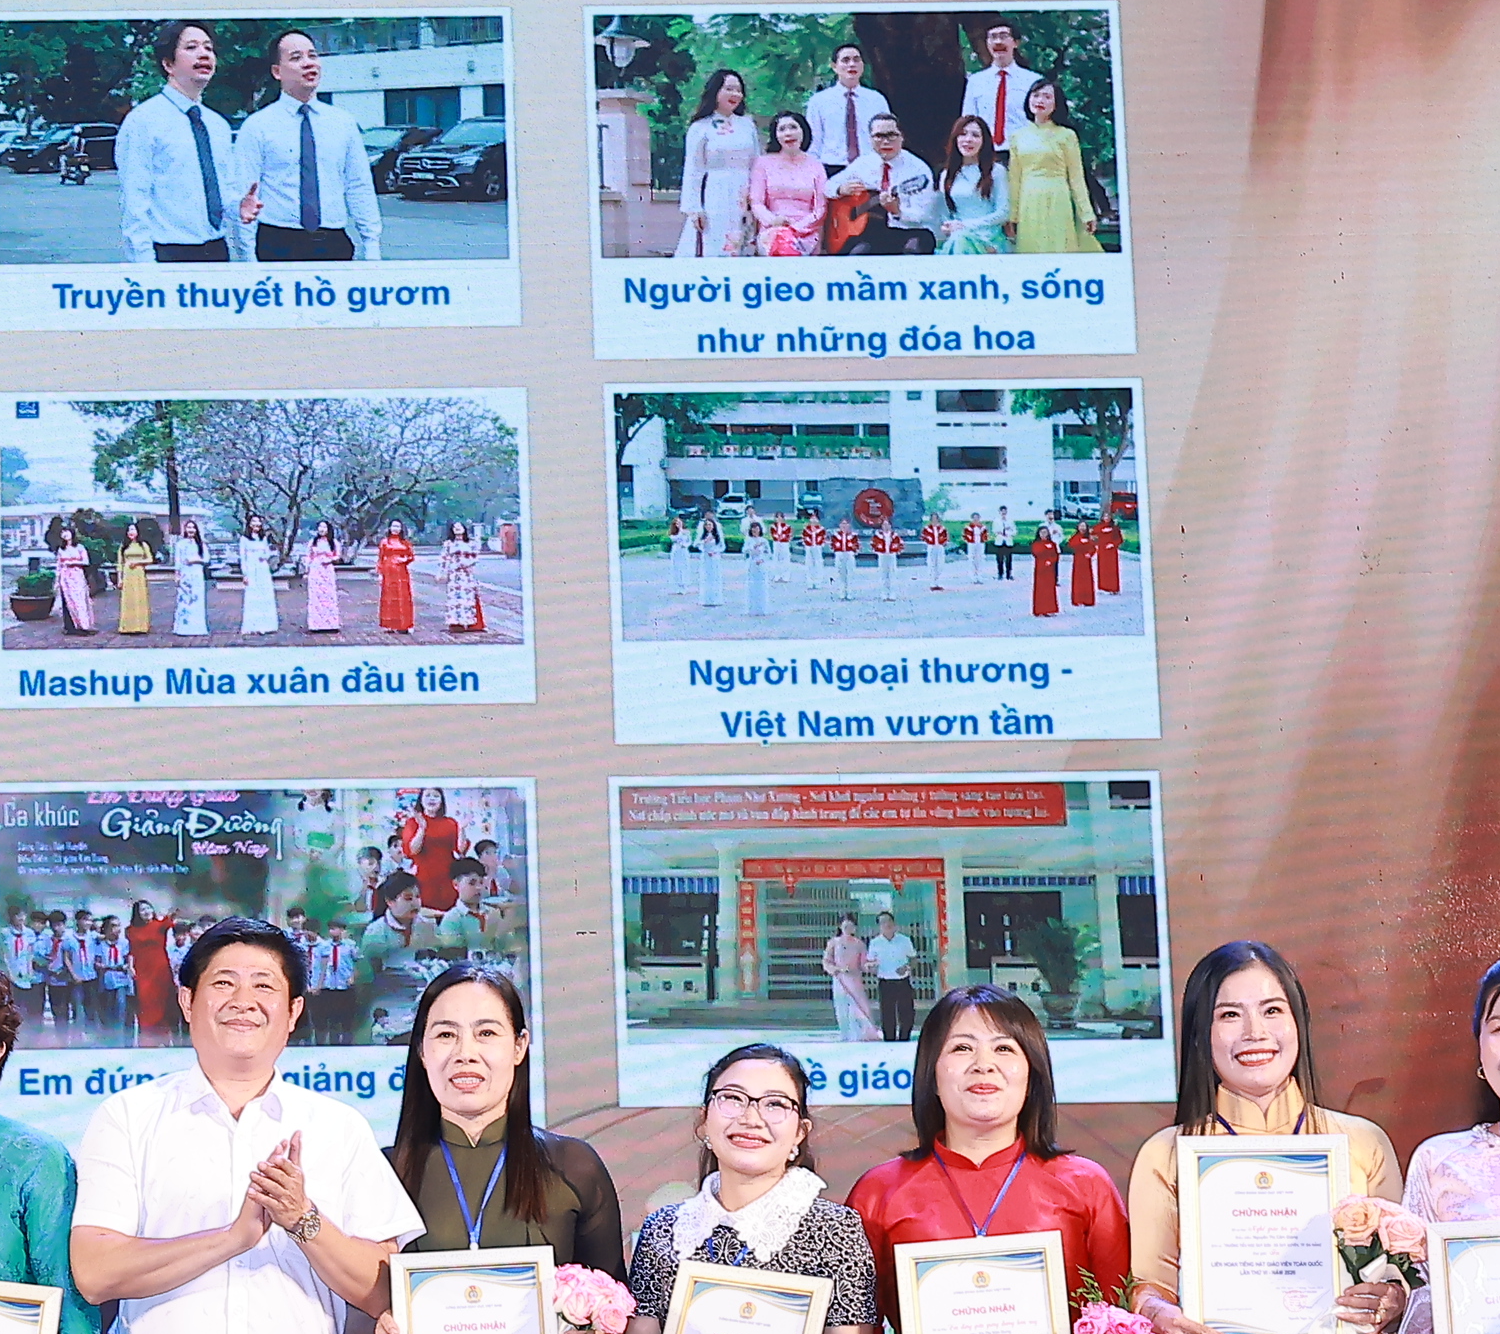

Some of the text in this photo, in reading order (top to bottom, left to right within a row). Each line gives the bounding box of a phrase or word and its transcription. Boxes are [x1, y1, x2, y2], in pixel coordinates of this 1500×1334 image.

[51, 275, 450, 316] Truyền thuyết hồ gươm
[624, 267, 1105, 310] Người gieo mầm xanh, sống
[697, 324, 1036, 360] như những đóa hoa
[19, 660, 480, 703] Mashup Mùa xuân đầu tiên
[689, 657, 798, 693] Người
[810, 657, 909, 692] Ngoại
[919, 657, 1050, 690] thương
[720, 702, 1054, 745] Việt Nam vươn tầm
[35, 801, 80, 827] khúc
[102, 807, 185, 862] Giảng
[182, 807, 283, 862] Đường
[19, 1068, 73, 1096] Em
[838, 1061, 912, 1098] giáo
[1232, 1207, 1298, 1218] CHỨNG NHẬN
[443, 1321, 506, 1333] CHỨNG NHẬN
[951, 1304, 1016, 1317] CHỨNG NHẬN
